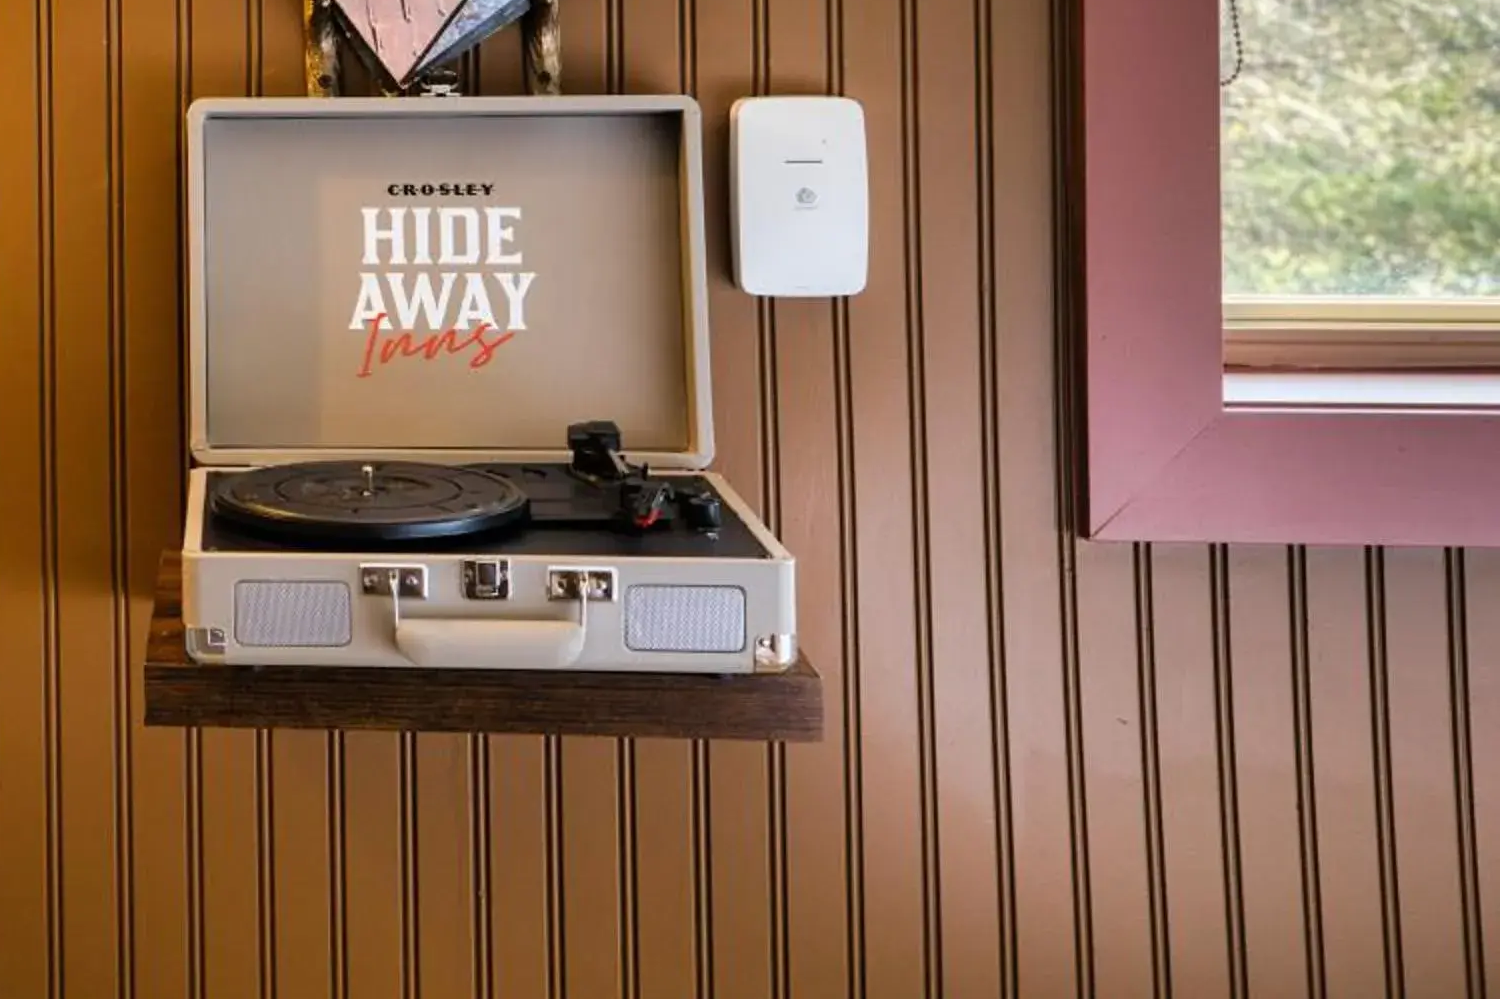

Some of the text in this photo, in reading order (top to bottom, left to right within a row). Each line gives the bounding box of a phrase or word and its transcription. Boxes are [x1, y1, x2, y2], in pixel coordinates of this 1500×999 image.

[387, 183, 494, 197] CROSLEY
[360, 206, 523, 265] HIDE
[348, 272, 538, 330] AWAY
[356, 312, 515, 378] Inns
